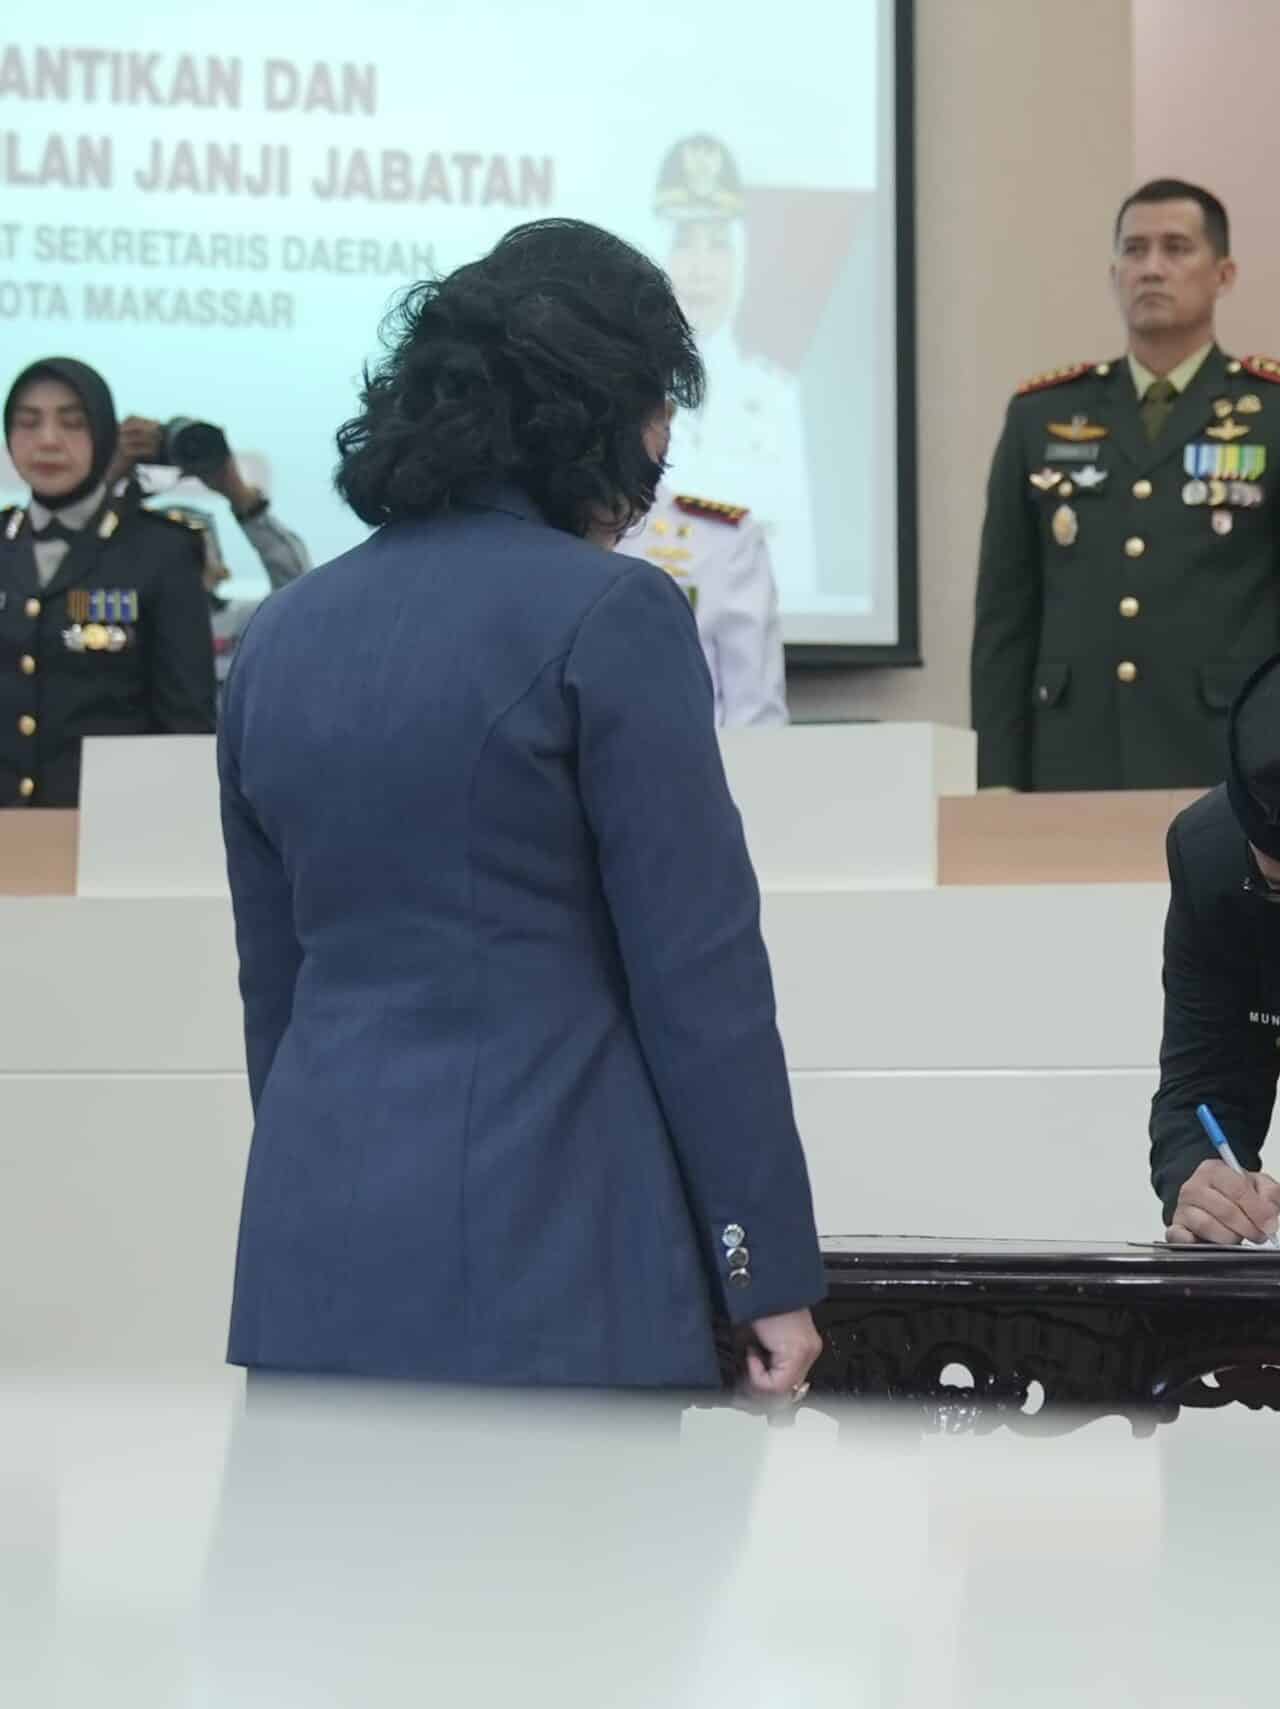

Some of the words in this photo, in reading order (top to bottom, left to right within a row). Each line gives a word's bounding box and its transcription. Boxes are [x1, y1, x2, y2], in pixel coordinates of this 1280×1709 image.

[0, 44, 241, 109] ANTIKAN
[264, 58, 378, 115] DAN
[134, 138, 291, 198] JANJI
[311, 146, 555, 209] JABATAN
[35, 224, 270, 272] SEKRETARIS
[281, 235, 434, 277] DAERAH
[84, 283, 296, 330] MAKASSAR
